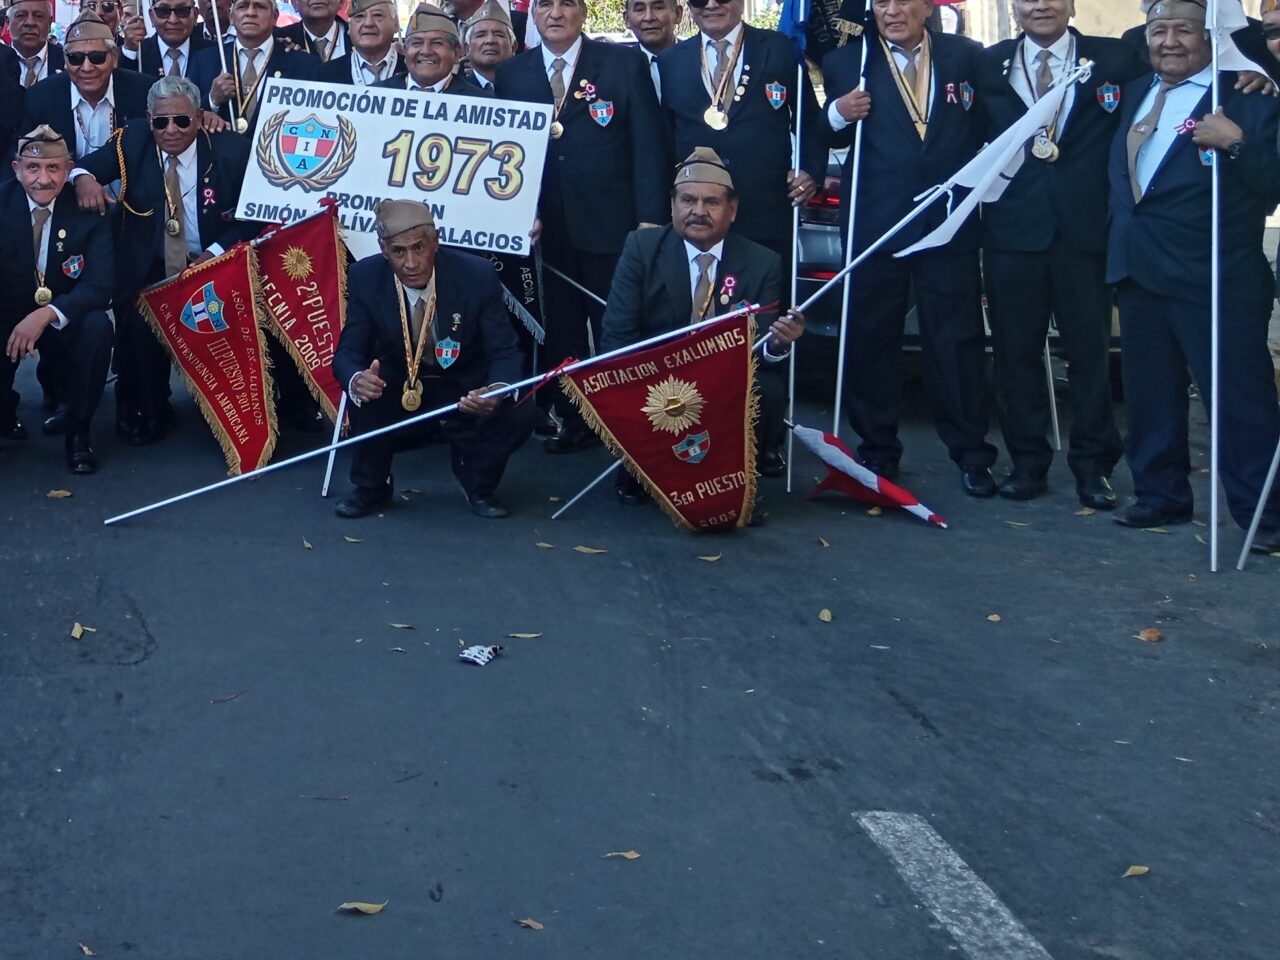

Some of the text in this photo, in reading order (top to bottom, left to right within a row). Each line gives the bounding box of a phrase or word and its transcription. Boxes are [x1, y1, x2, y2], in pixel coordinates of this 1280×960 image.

[266, 85, 547, 131] PROMOCIÓN DE LA AMISTAD
[289, 126, 331, 139] C N
[303, 141, 309, 152] I
[295, 158, 308, 170] A
[382, 129, 526, 201] 1973
[244, 202, 307, 223] SIMÓN
[438, 226, 523, 252] ALACIOS
[241, 327, 252, 342] DE
[301, 295, 335, 367] PUESTO
[294, 334, 321, 372] 2009
[583, 327, 746, 395] ASOCIACION EXALUMNOS
[214, 391, 250, 445] AMERICANA
[235, 391, 252, 414] 2011
[670, 470, 746, 508] 3ER PUESTO
